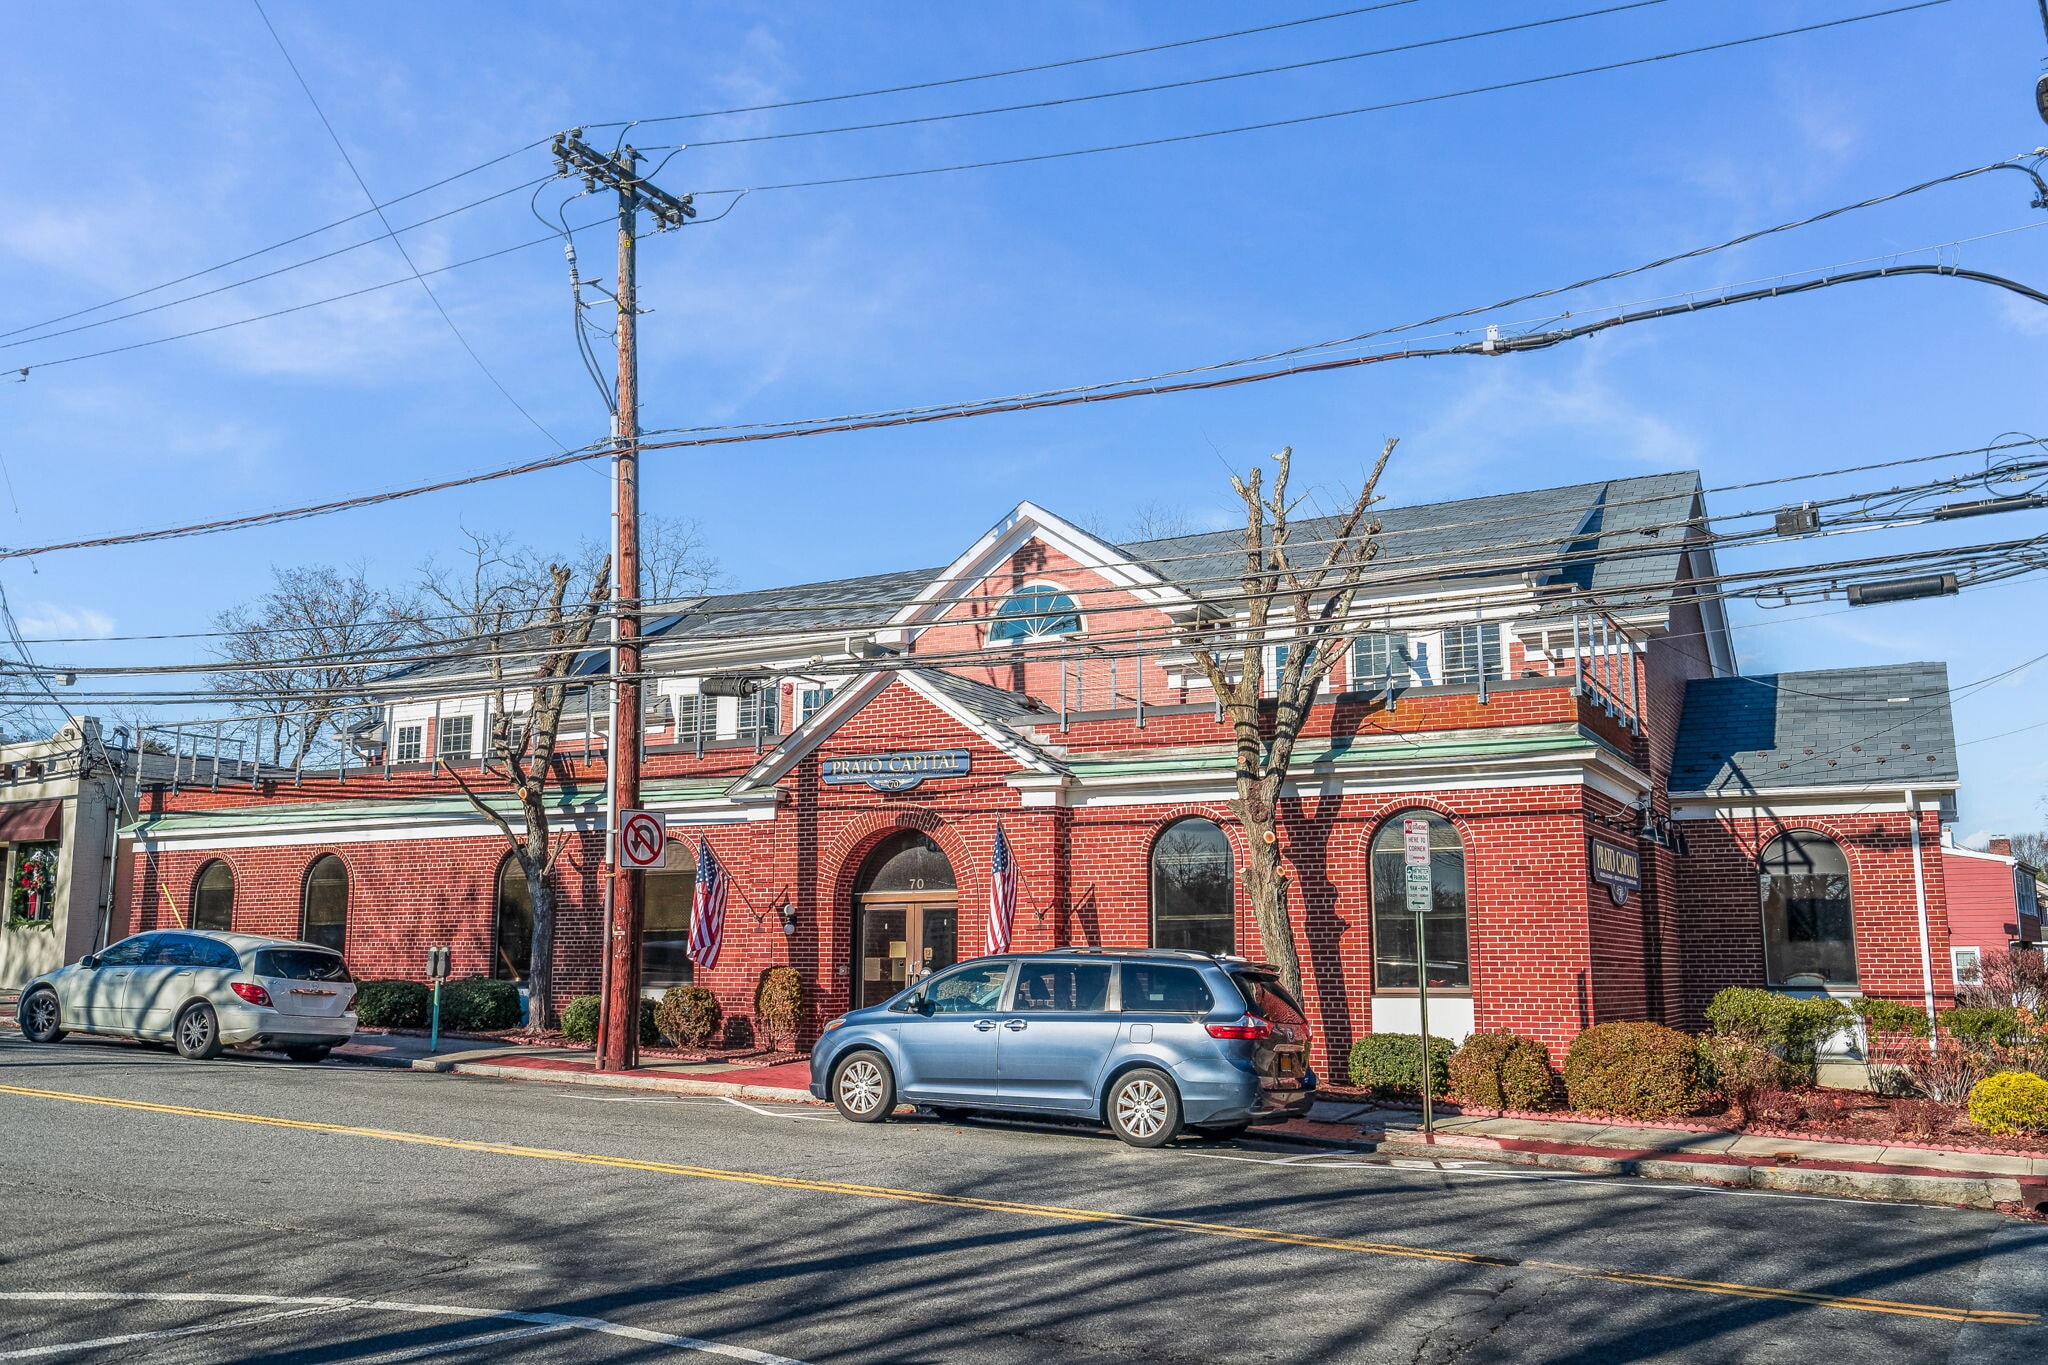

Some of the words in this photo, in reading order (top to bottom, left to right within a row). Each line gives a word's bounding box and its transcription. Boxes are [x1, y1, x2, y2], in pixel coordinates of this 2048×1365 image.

[831, 758, 882, 775] PRATO
[889, 753, 959, 772] CAPITAL
[1596, 844, 1615, 872] PRATO
[1616, 851, 1639, 878] CAPITAL
[909, 878, 924, 889] 70
